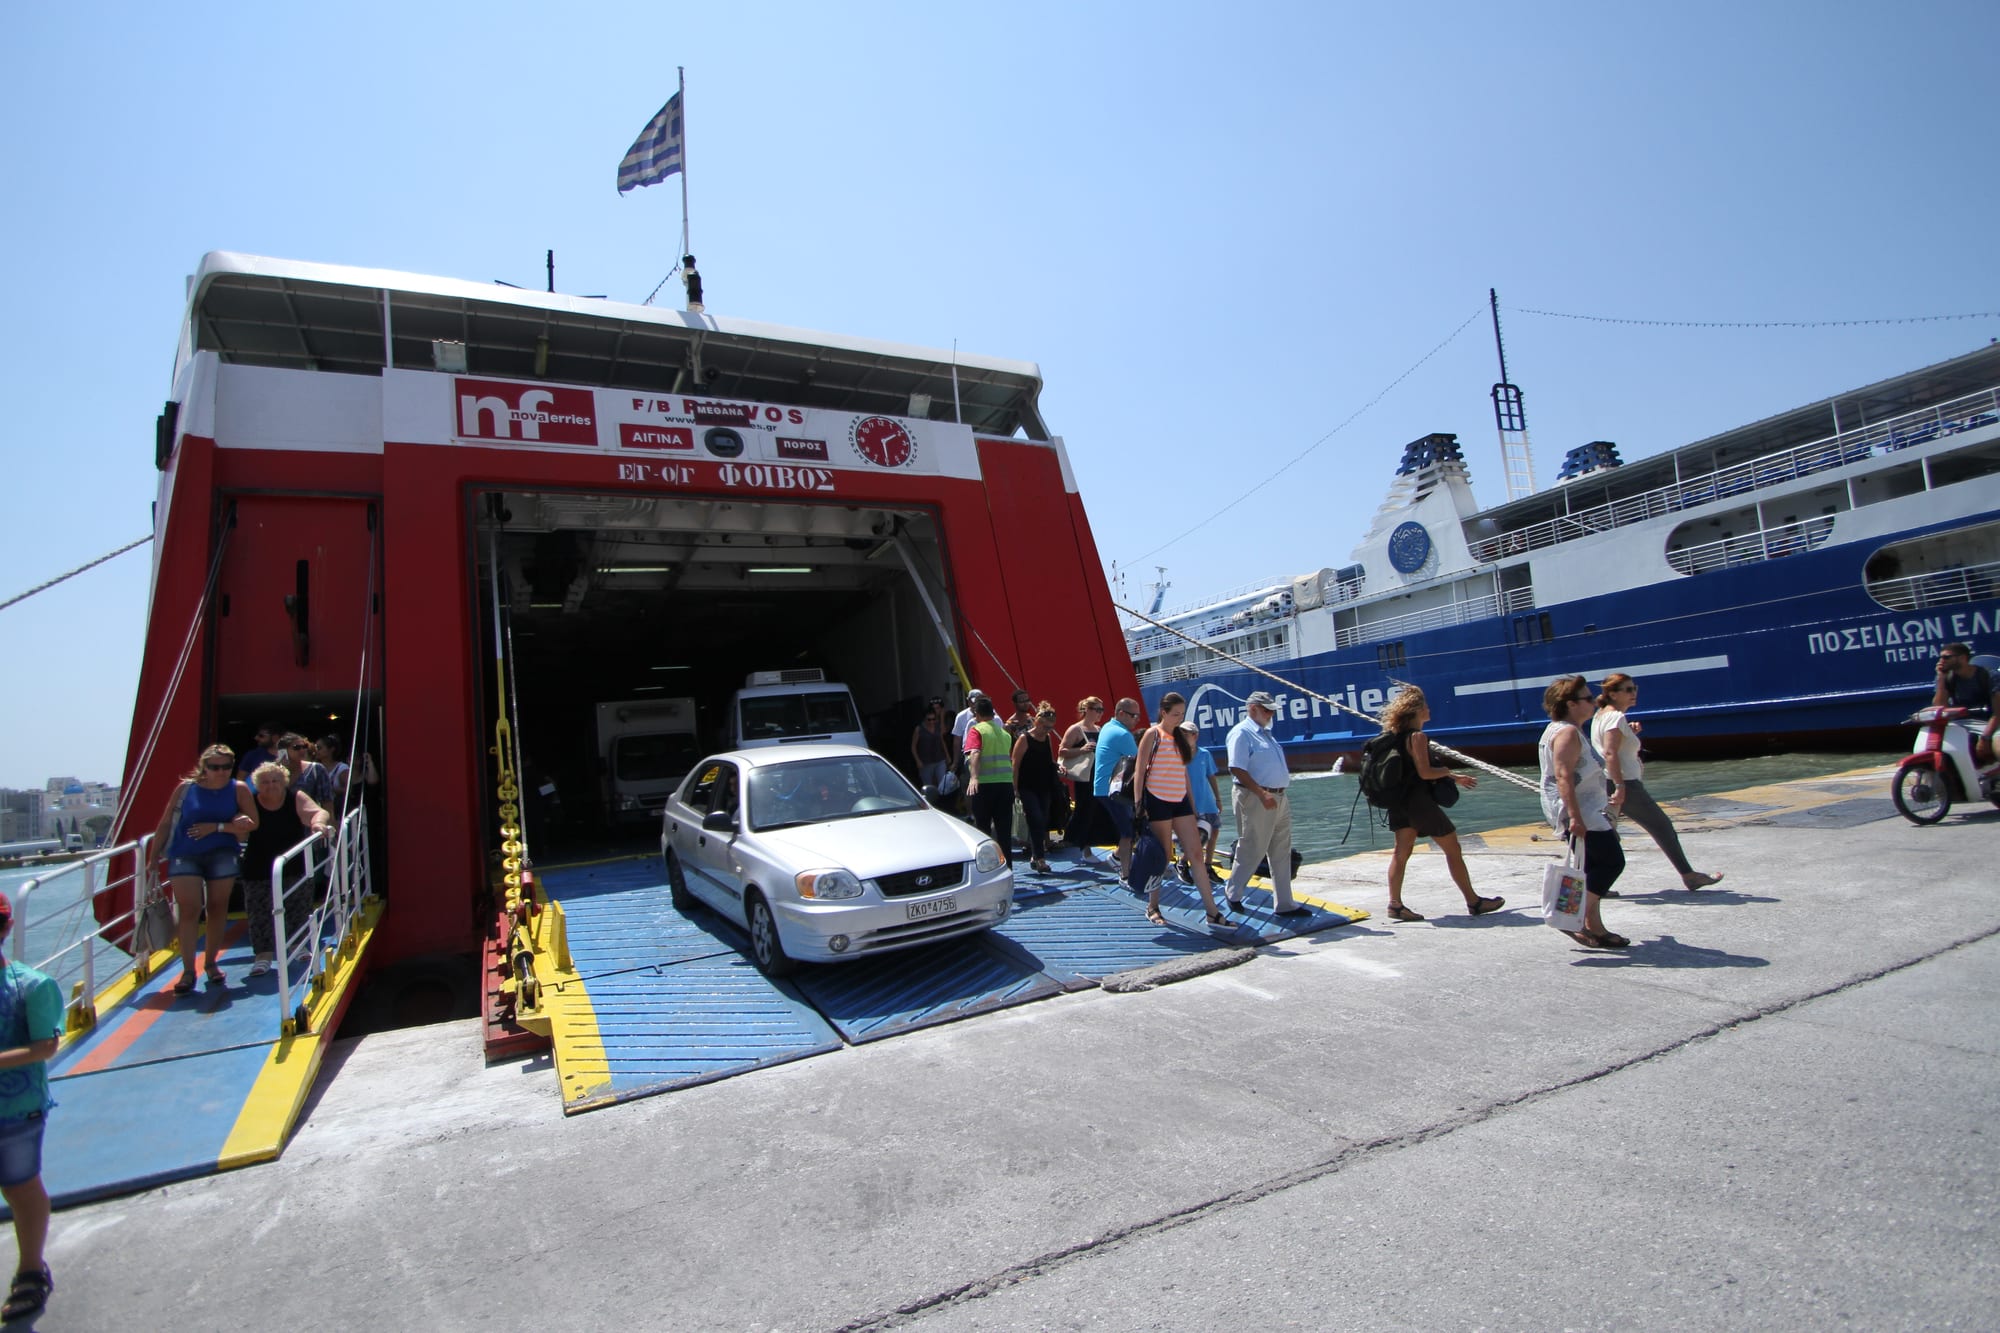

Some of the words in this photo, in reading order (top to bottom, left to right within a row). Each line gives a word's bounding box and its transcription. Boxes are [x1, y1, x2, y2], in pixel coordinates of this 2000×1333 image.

[461, 389, 554, 440] nf
[632, 398, 671, 413] F/B
[682, 399, 804, 424] PVOS
[632, 431, 683, 445] ΑΙΓΙΝΑ
[783, 440, 822, 451] ΠΟΡΟΣ
[718, 463, 835, 491] ΦΟΙΒΟΣ
[1808, 616, 1944, 655] ΠΟΣΕΙΔΩΝ
